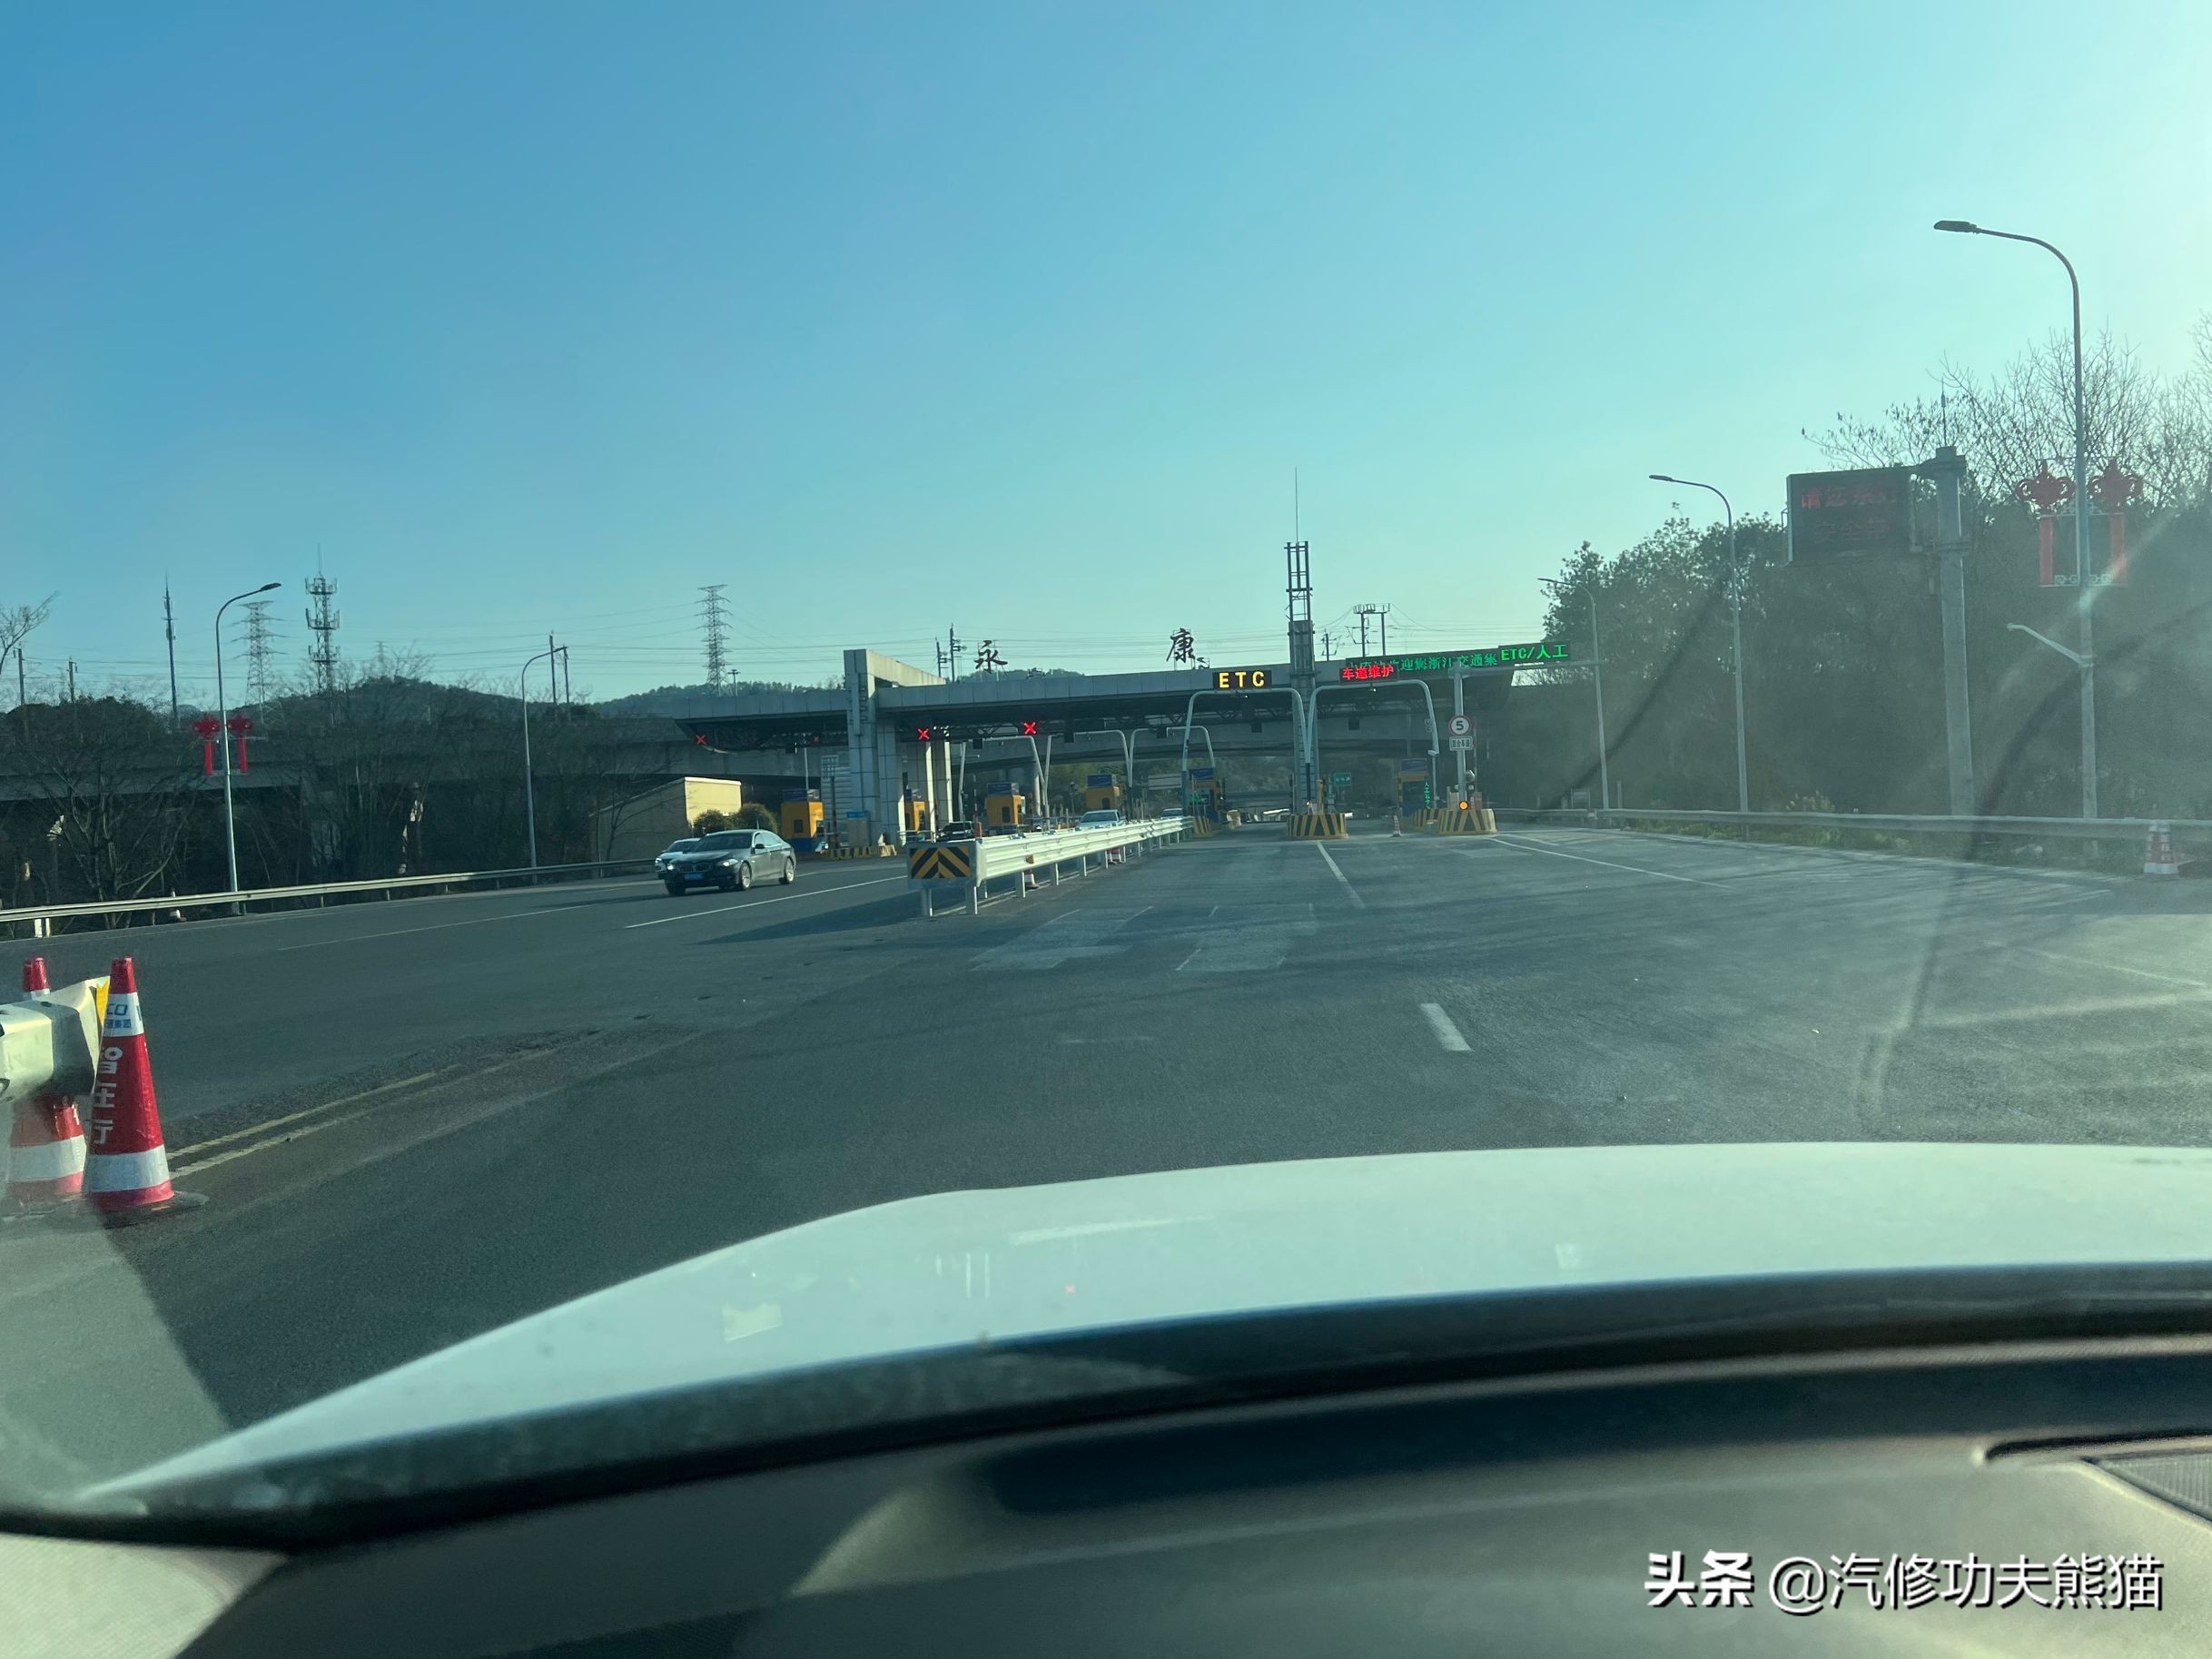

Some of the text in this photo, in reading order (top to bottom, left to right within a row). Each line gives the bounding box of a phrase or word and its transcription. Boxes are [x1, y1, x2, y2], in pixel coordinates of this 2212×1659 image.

[973, 627, 1195, 674] 永 康
[1501, 644, 1569, 662] ETC/人工
[1219, 671, 1265, 688] ETC
[1342, 664, 1394, 680] 车道维护
